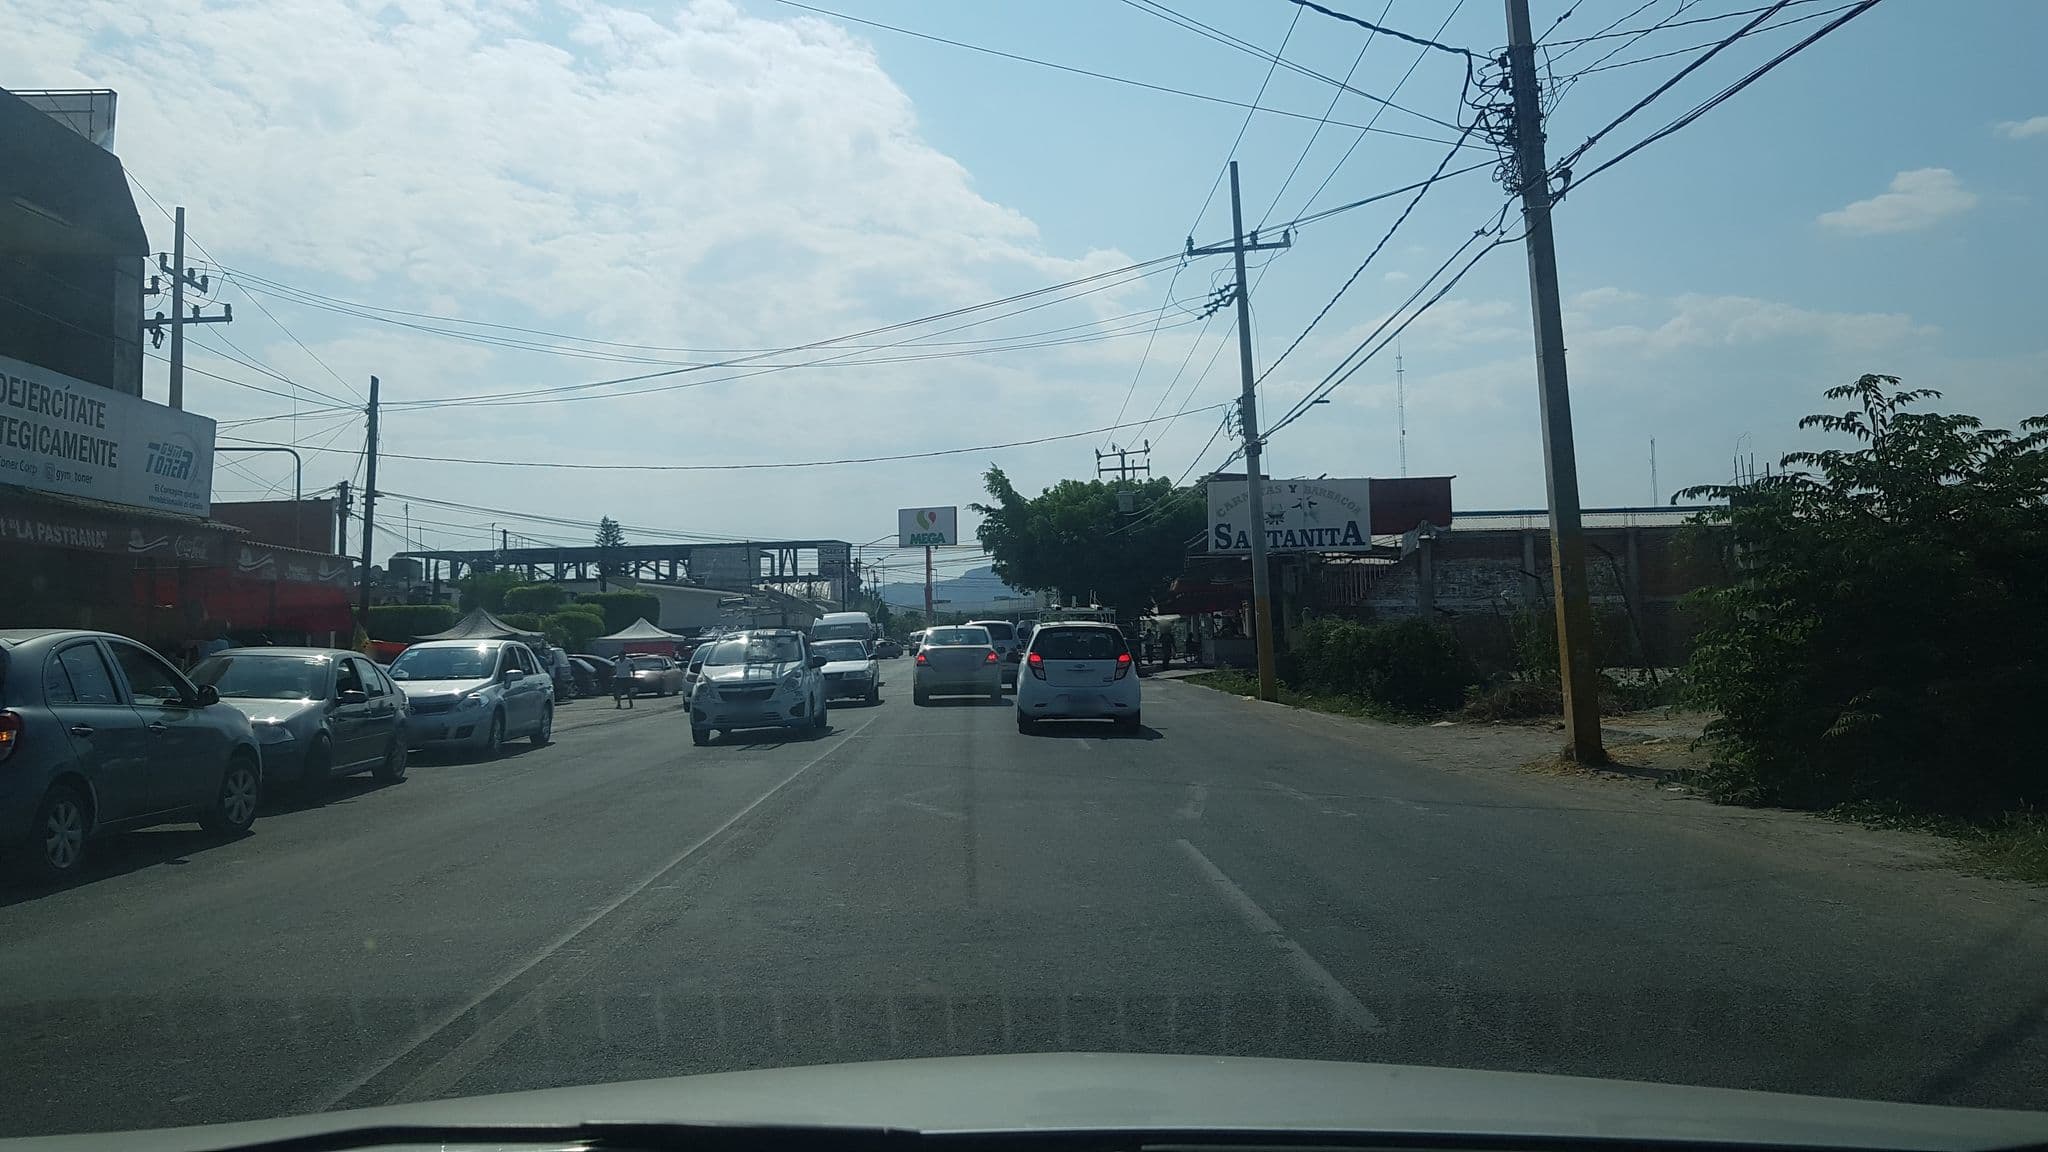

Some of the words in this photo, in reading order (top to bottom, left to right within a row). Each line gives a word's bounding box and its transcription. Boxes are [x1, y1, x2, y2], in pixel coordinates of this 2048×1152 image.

[1288, 484, 1298, 493] Y
[910, 532, 946, 545] MEGA
[1215, 521, 1366, 549] SATANITA
